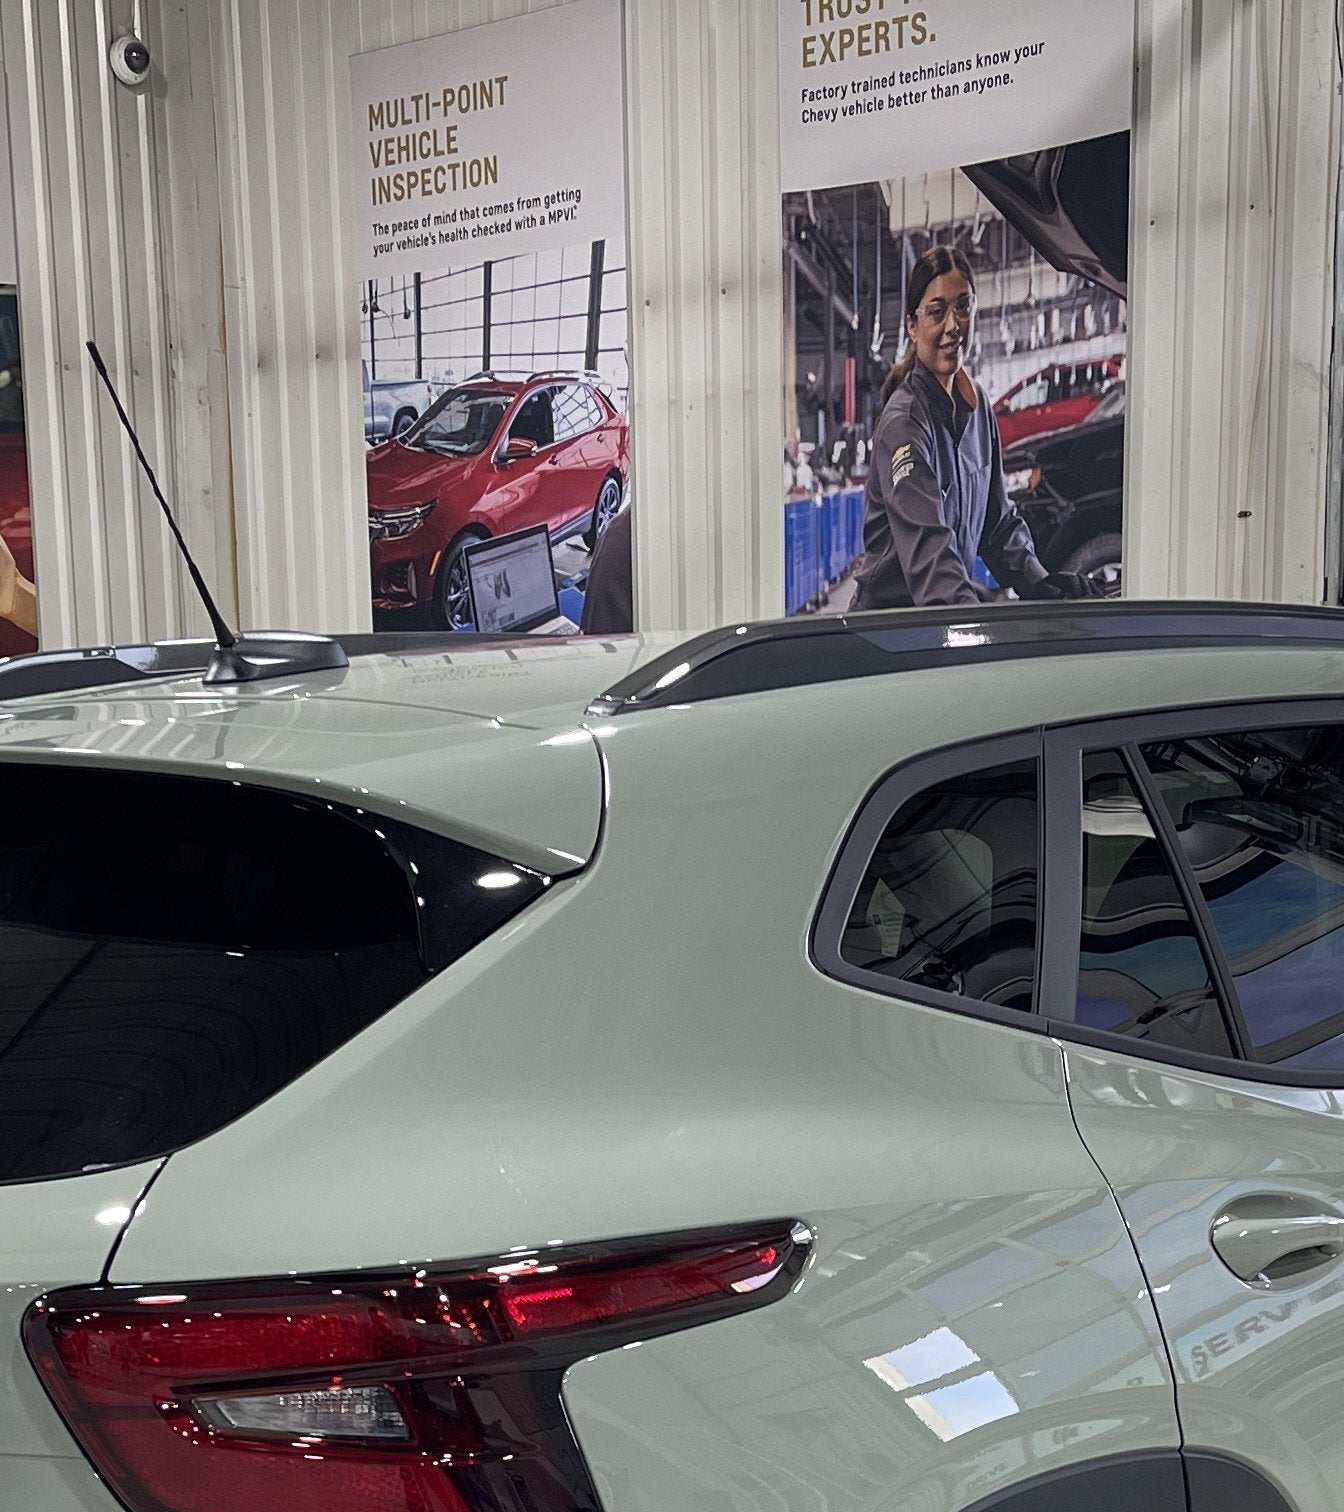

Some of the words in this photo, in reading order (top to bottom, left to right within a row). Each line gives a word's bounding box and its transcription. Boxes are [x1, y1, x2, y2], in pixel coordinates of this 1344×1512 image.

[801, 0, 884, 26] TRU
[802, 11, 936, 68] EXPERTS.
[801, 83, 848, 103] Factory
[851, 71, 896, 95] trained
[899, 57, 972, 85] technicians
[976, 50, 1011, 69] know
[1013, 42, 1045, 64] your
[368, 75, 508, 132] MULTI-POINT
[801, 107, 838, 124] Chevy
[841, 97, 884, 117] vehicle
[888, 90, 927, 110] better
[931, 83, 960, 100] than
[963, 73, 1014, 95] anyone.
[369, 124, 459, 169] VEHICLE
[371, 155, 499, 206] INSPECTION
[372, 223, 390, 237] The
[391, 218, 419, 237] peace
[421, 213, 432, 228] of
[433, 209, 457, 226] mind
[459, 207, 480, 222] that
[482, 202, 515, 218] comes
[516, 195, 541, 212] from
[544, 188, 582, 210] getting
[372, 242, 394, 258] your
[396, 231, 437, 251] vehicle's
[438, 227, 469, 244] health
[471, 218, 512, 239] checked
[514, 214, 537, 231] with
[539, 215, 546, 226] a
